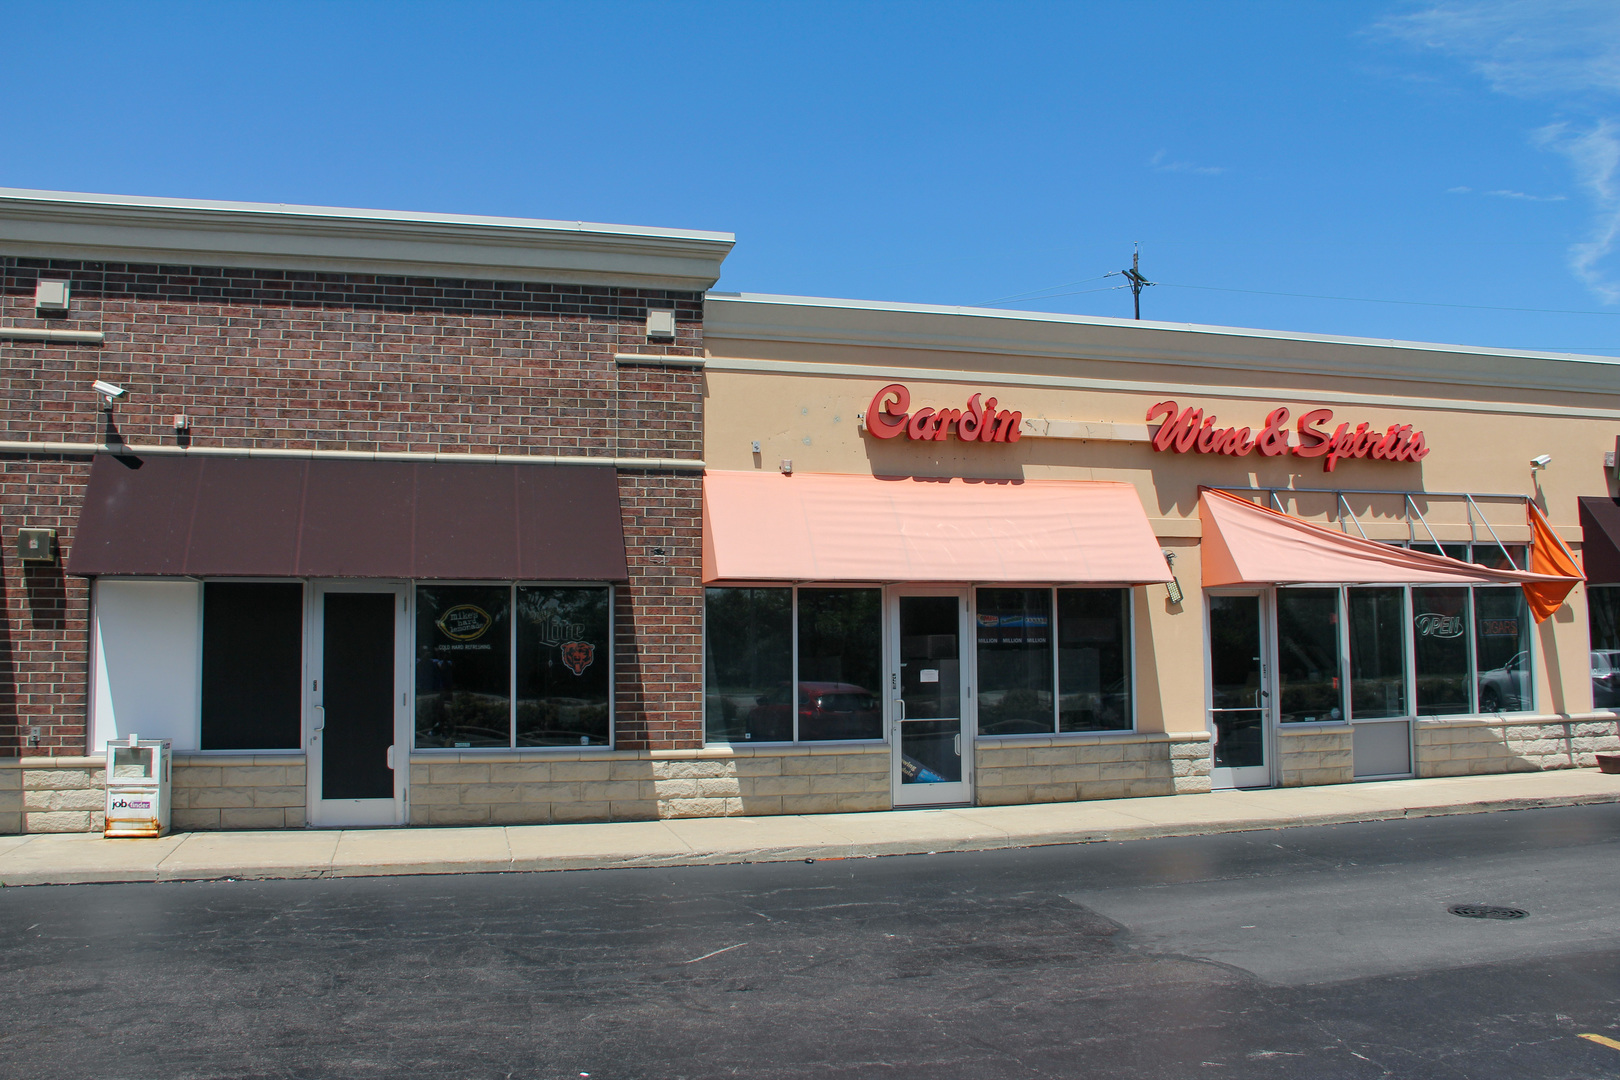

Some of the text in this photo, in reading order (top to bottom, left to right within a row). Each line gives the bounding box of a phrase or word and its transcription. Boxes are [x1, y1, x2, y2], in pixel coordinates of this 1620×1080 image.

[866, 384, 1023, 443] Cardin
[1146, 401, 1430, 473] Wine & Spirits
[1420, 616, 1460, 636] OPEN
[1482, 620, 1518, 635] CIGARS
[112, 798, 150, 810] job finder
